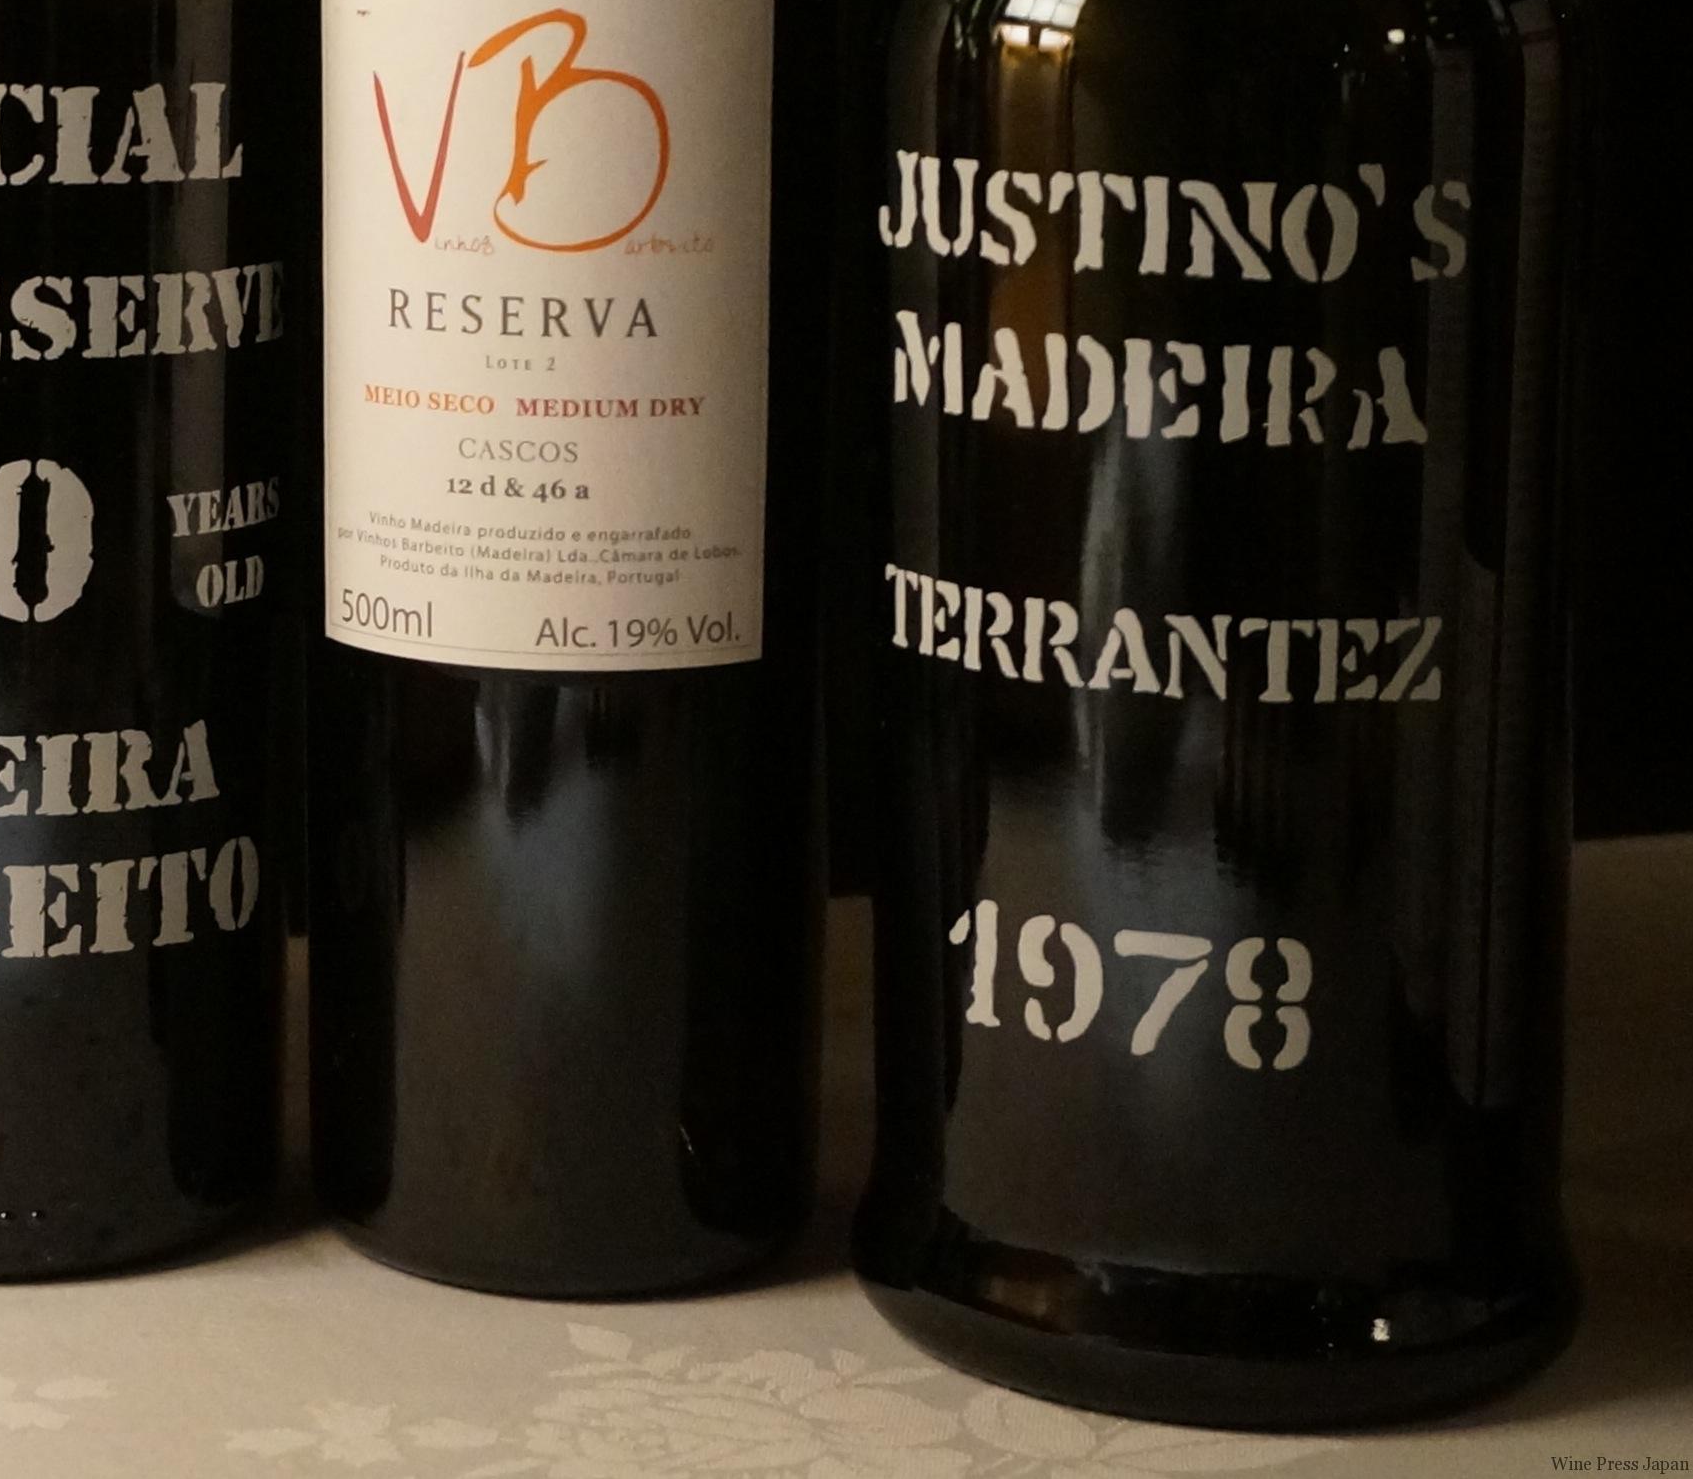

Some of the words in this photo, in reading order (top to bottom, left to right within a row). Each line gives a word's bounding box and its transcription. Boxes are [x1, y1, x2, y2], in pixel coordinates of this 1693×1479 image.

[878, 149, 1471, 283] JUSTINO'S
[388, 288, 658, 338] RESERVA
[546, 357, 556, 371] 2
[894, 309, 1429, 450] MADEIRA
[365, 384, 420, 409] MEIO
[428, 392, 496, 415] SECO
[516, 397, 639, 418] MEDIUM
[650, 396, 706, 418] DRY
[458, 437, 579, 464] CASCOS
[167, 476, 280, 537] YEARS
[446, 477, 473, 495] 12
[480, 475, 496, 497] d
[504, 476, 524, 499] &
[532, 479, 566, 503] 46
[575, 483, 590, 500] a
[356, 528, 397, 549] Vinhos
[402, 538, 464, 557] Barbeito
[470, 545, 551, 563] (Madeira)
[669, 548, 688, 561] de
[369, 511, 406, 529] Vinho
[410, 516, 471, 537] Madeira
[477, 525, 565, 542] produzido
[571, 530, 581, 542] e
[587, 526, 691, 546] engarrafado
[195, 554, 265, 607] OLD
[380, 554, 435, 575] Produto
[440, 563, 458, 577] da
[464, 566, 494, 580] Ilha
[500, 568, 520, 582] da
[341, 588, 433, 638] 500ml
[535, 617, 597, 649] Alc.
[607, 617, 678, 649] 19%
[688, 611, 740, 645] Vol.
[885, 563, 1442, 703] TERRANTEZ
[948, 899, 1313, 1072] 1978
